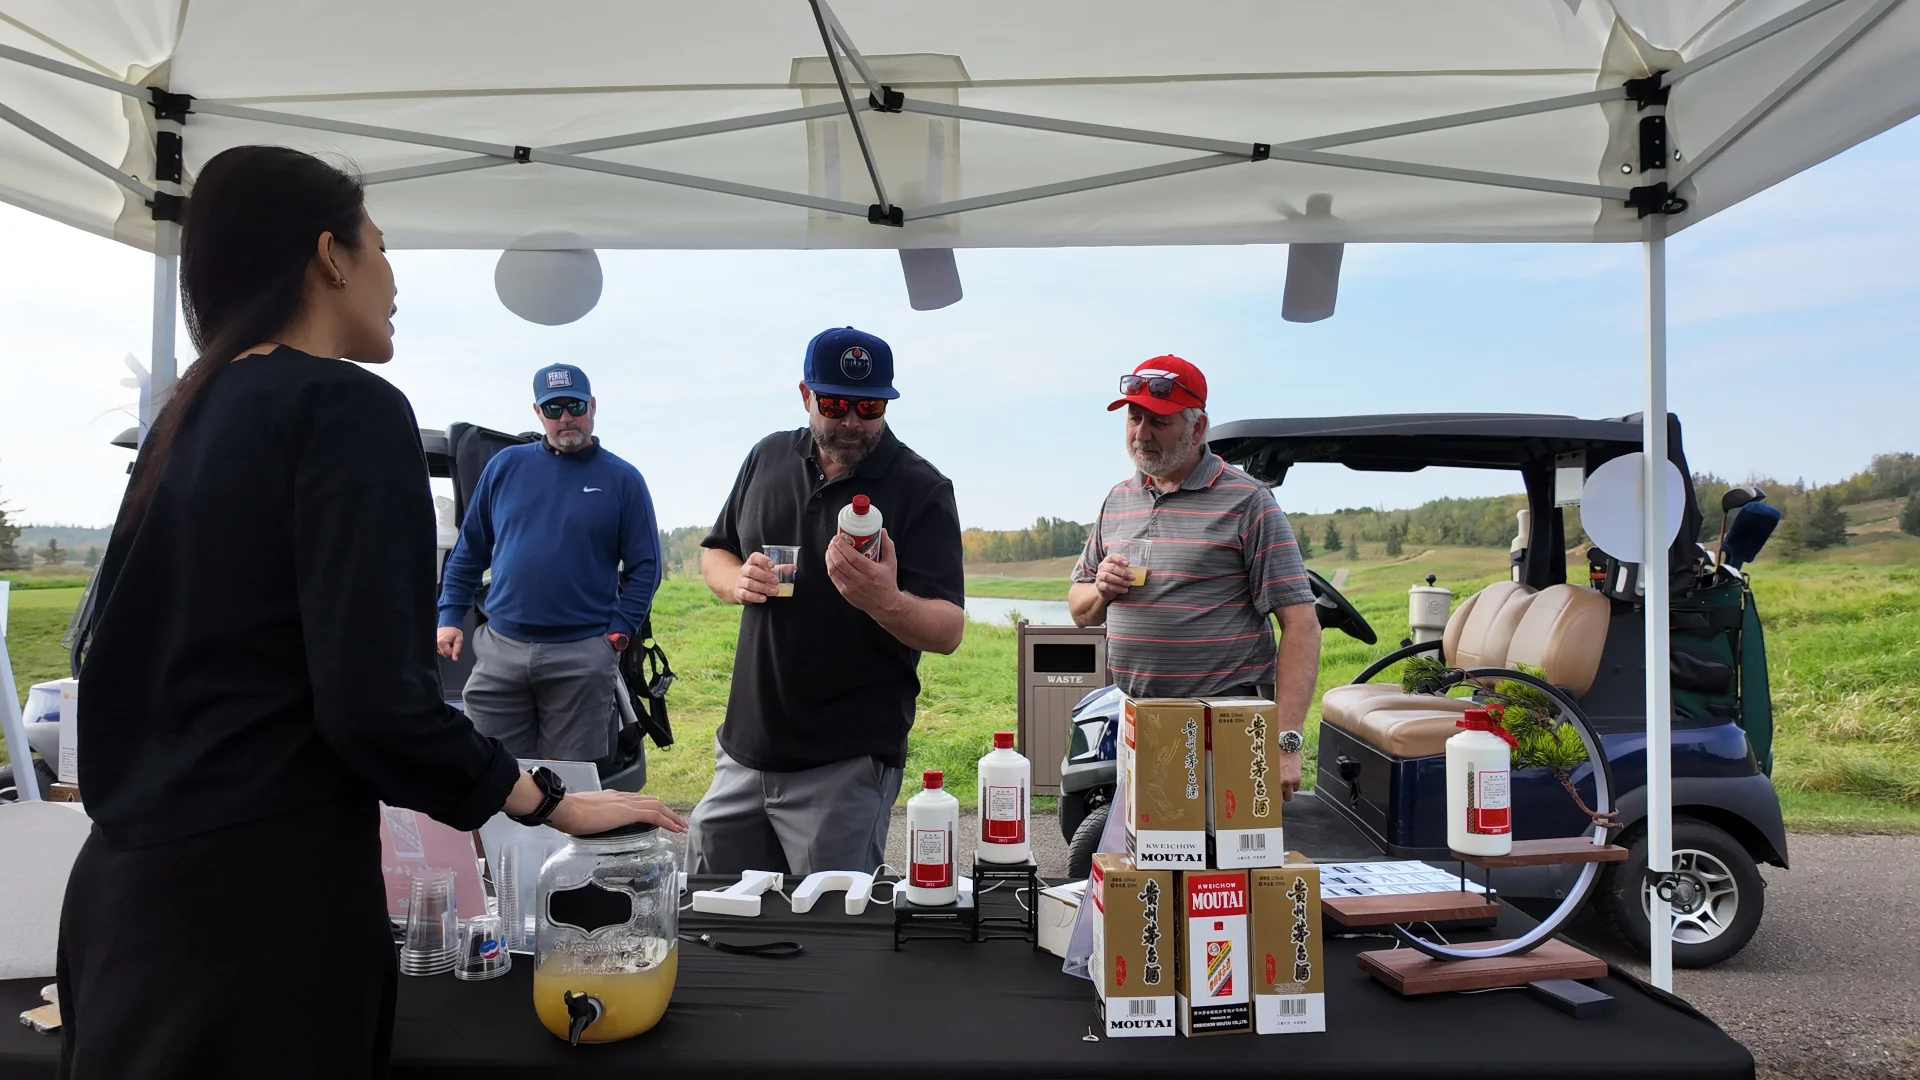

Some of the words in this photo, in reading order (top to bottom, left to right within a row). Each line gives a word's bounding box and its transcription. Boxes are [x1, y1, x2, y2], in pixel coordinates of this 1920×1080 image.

[1047, 675, 1083, 684] WASTE
[1141, 853, 1203, 862] MOUTAI
[1197, 882, 1236, 890] KWEICHOW
[1191, 890, 1244, 910] MOUTAI
[1110, 1019, 1172, 1029] MOUTAI
